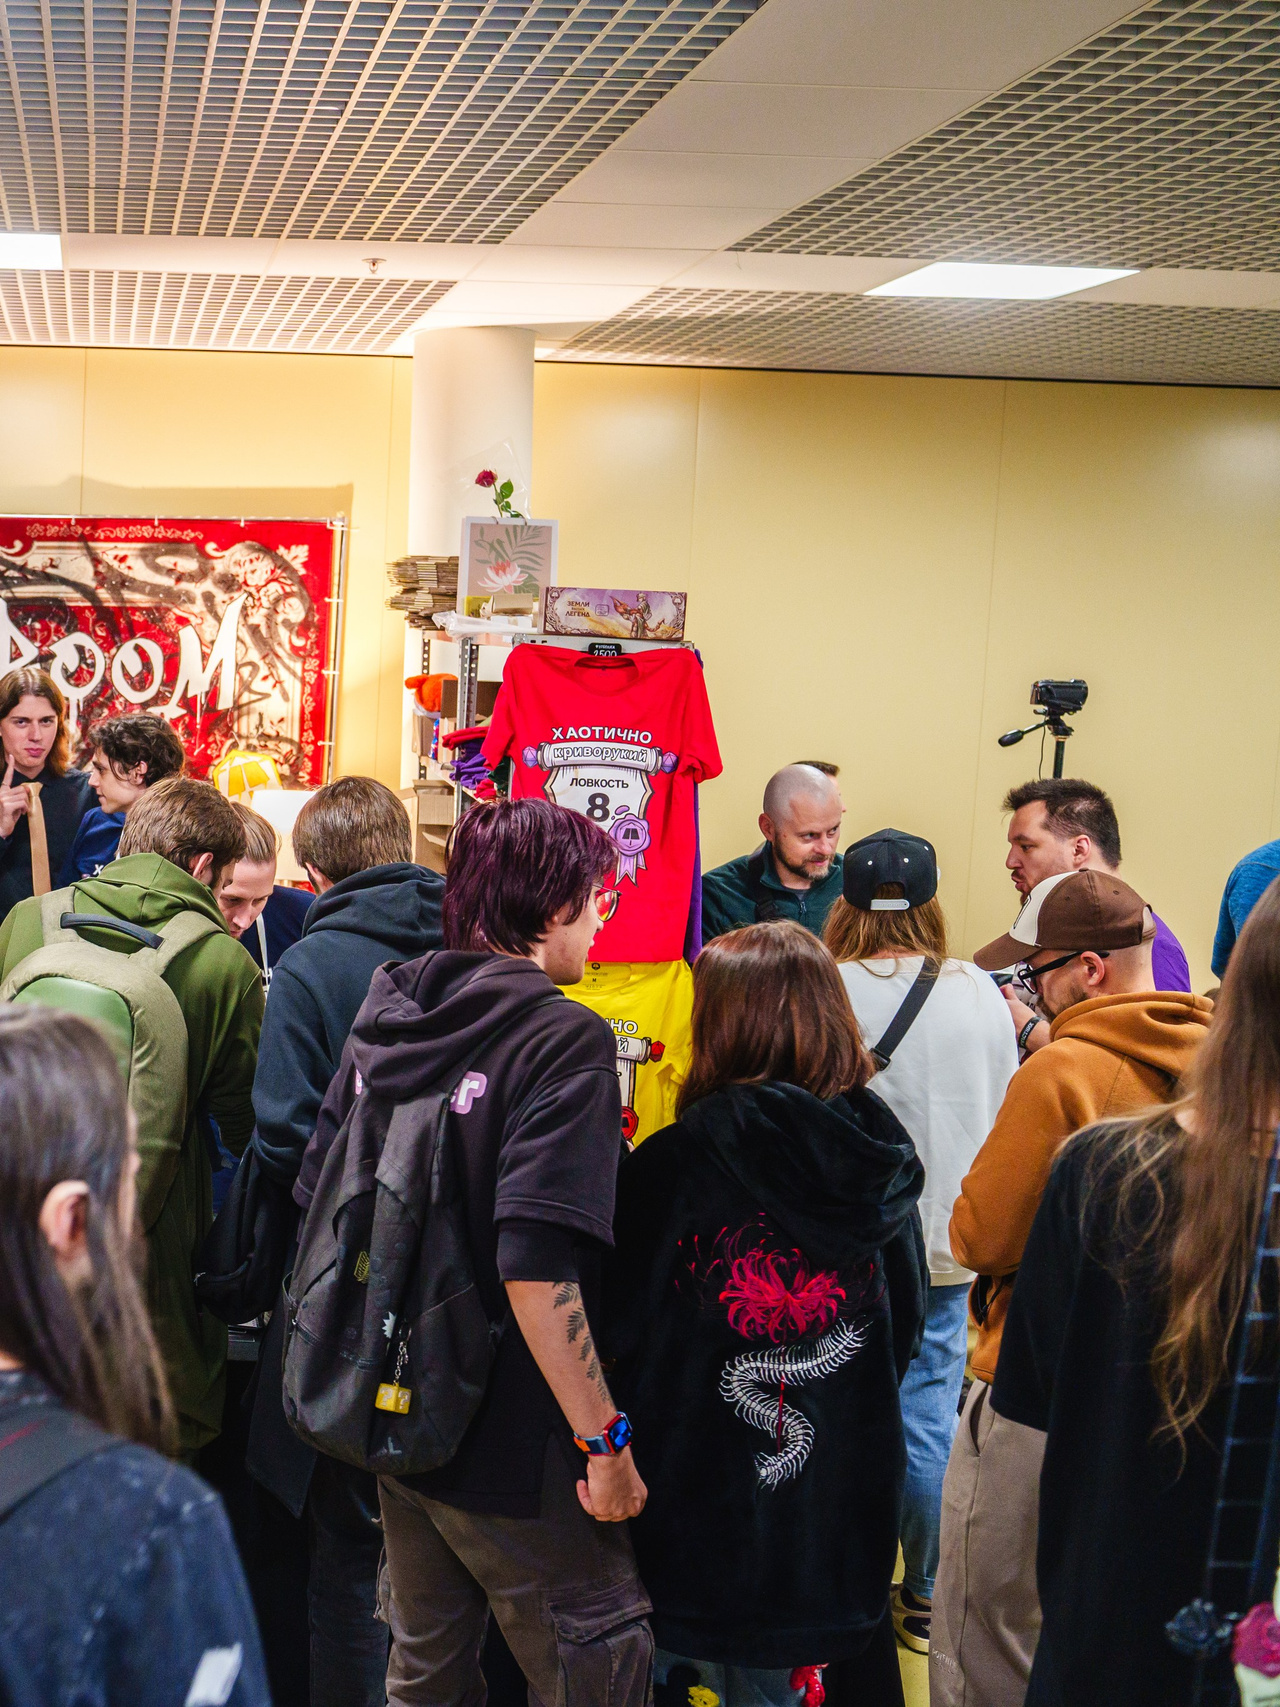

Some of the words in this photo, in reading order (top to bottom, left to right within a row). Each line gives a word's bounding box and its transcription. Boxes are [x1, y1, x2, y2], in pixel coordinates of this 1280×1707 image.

[551, 726, 652, 744] ХАОТИЧНО
[553, 746, 648, 763] криворукий
[569, 777, 630, 789] ЛОВКОСТЬ
[586, 792, 611, 823] 8
